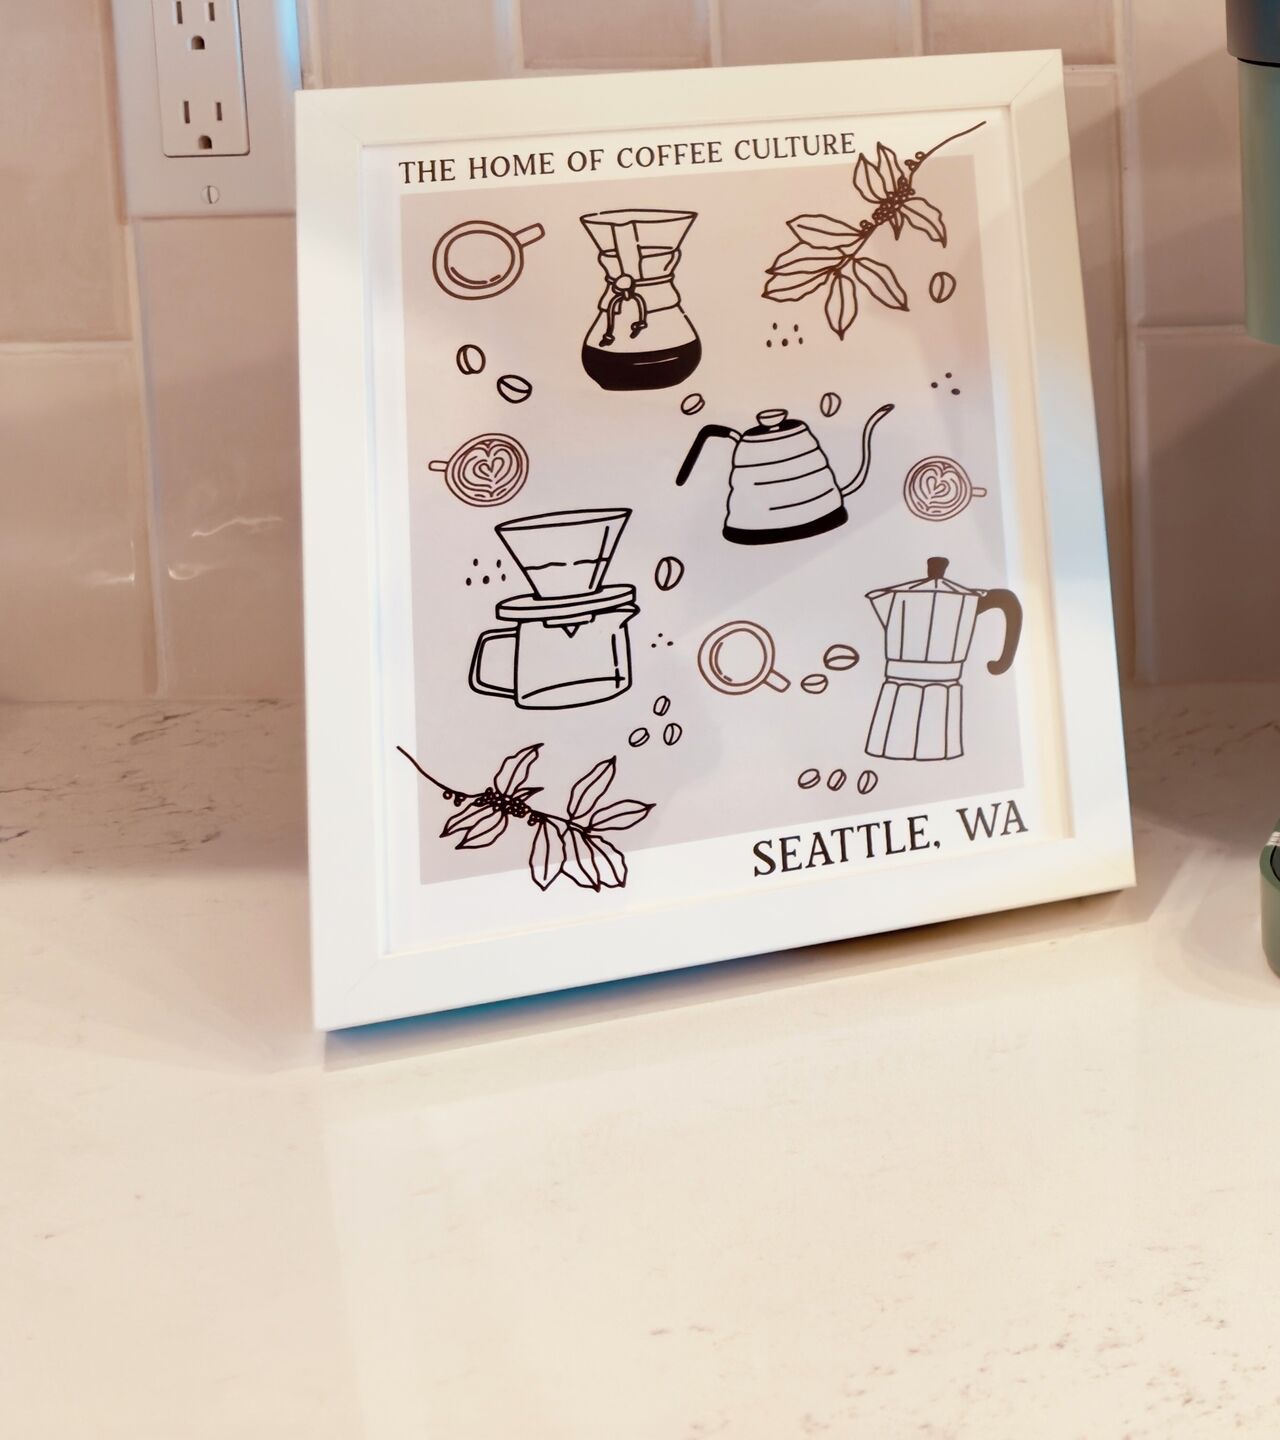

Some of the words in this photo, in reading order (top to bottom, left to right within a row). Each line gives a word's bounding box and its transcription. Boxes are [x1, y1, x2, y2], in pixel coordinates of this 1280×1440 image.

[398, 158, 456, 184] THE
[468, 152, 555, 180] HOME
[567, 148, 604, 172] OF
[616, 141, 723, 169] COFFEE
[734, 132, 856, 161] CULTURE
[752, 814, 941, 878] SEATTLE,
[956, 799, 1029, 841] WA
